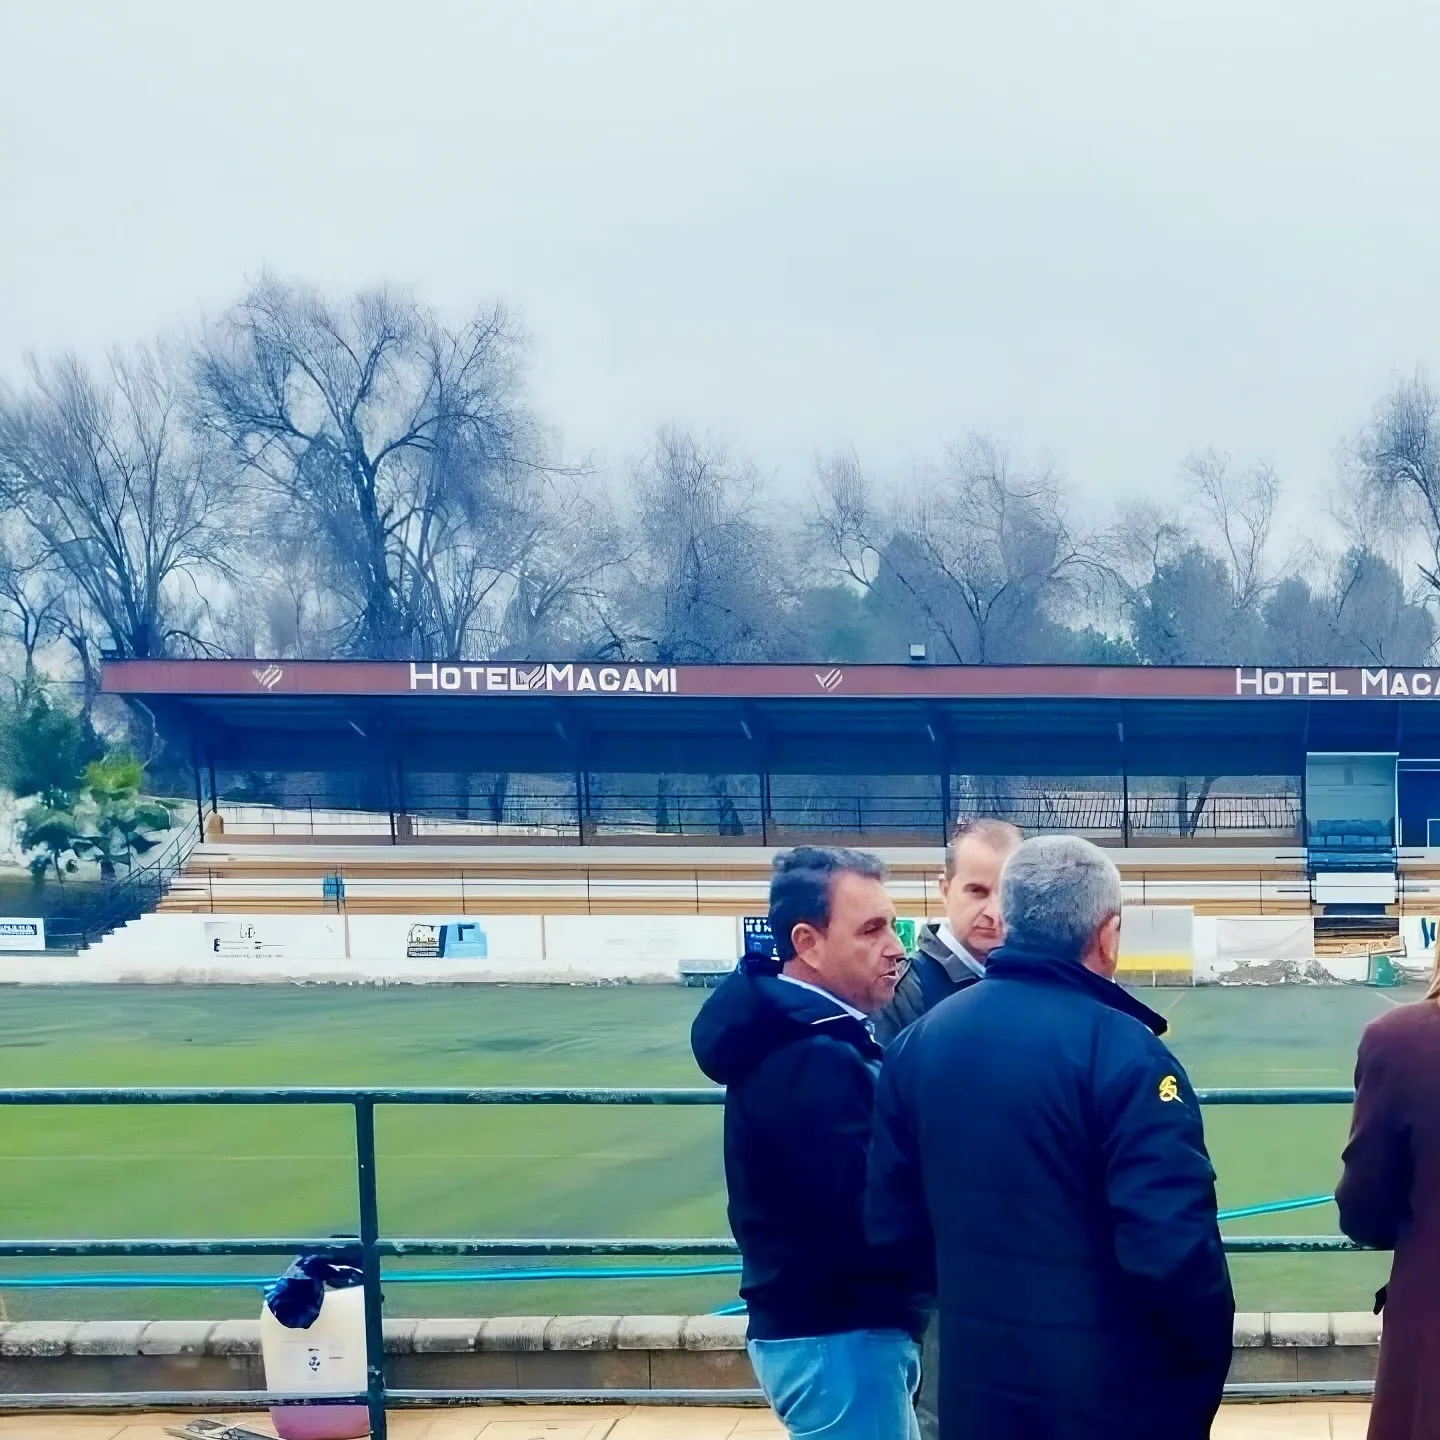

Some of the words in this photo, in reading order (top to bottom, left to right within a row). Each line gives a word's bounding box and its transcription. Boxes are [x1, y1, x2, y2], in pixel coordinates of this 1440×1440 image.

[410, 663, 530, 690] HOTEL
[546, 664, 678, 692] MACAMI
[1236, 668, 1348, 695] HOTEL
